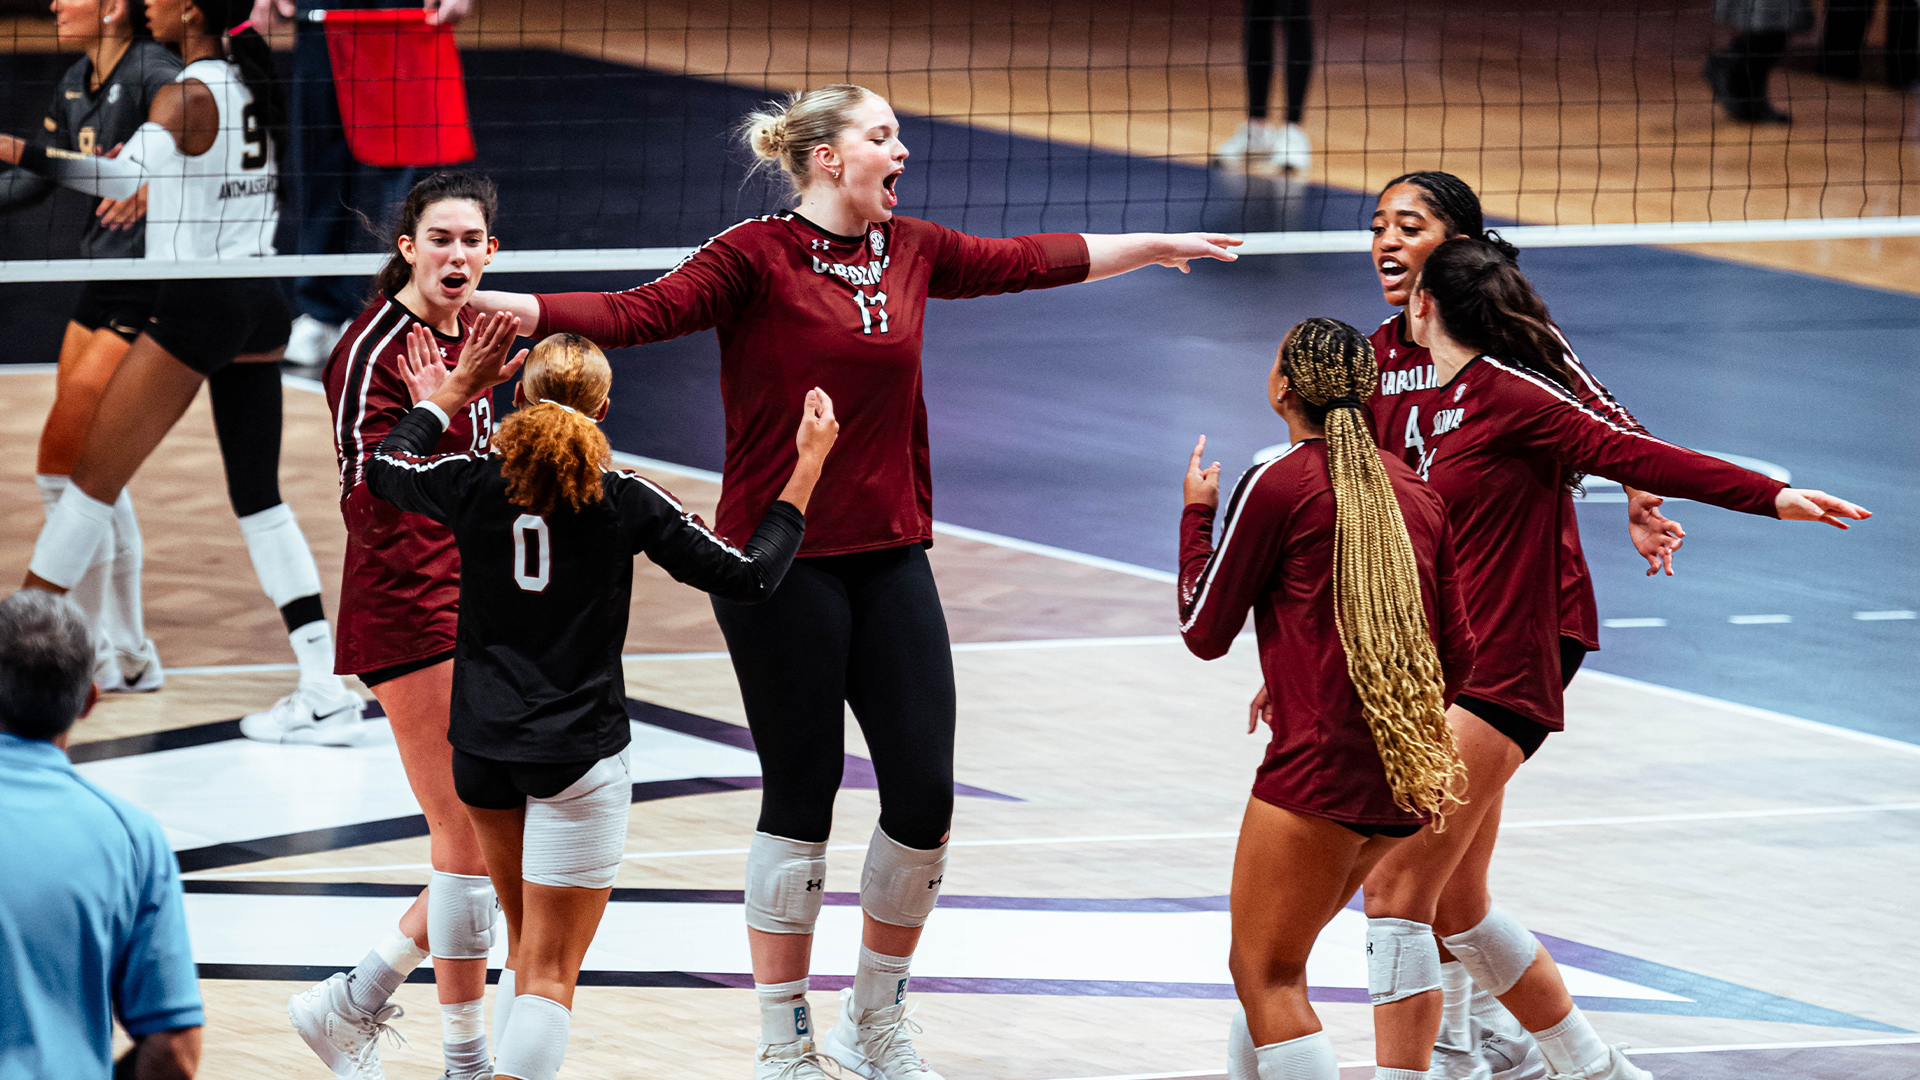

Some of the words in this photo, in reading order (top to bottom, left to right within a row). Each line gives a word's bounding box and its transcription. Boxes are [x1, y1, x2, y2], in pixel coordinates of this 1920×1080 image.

[852, 289, 889, 336] 17
[468, 395, 491, 451] 13
[1404, 404, 1425, 455] 4
[511, 513, 551, 594] 0
